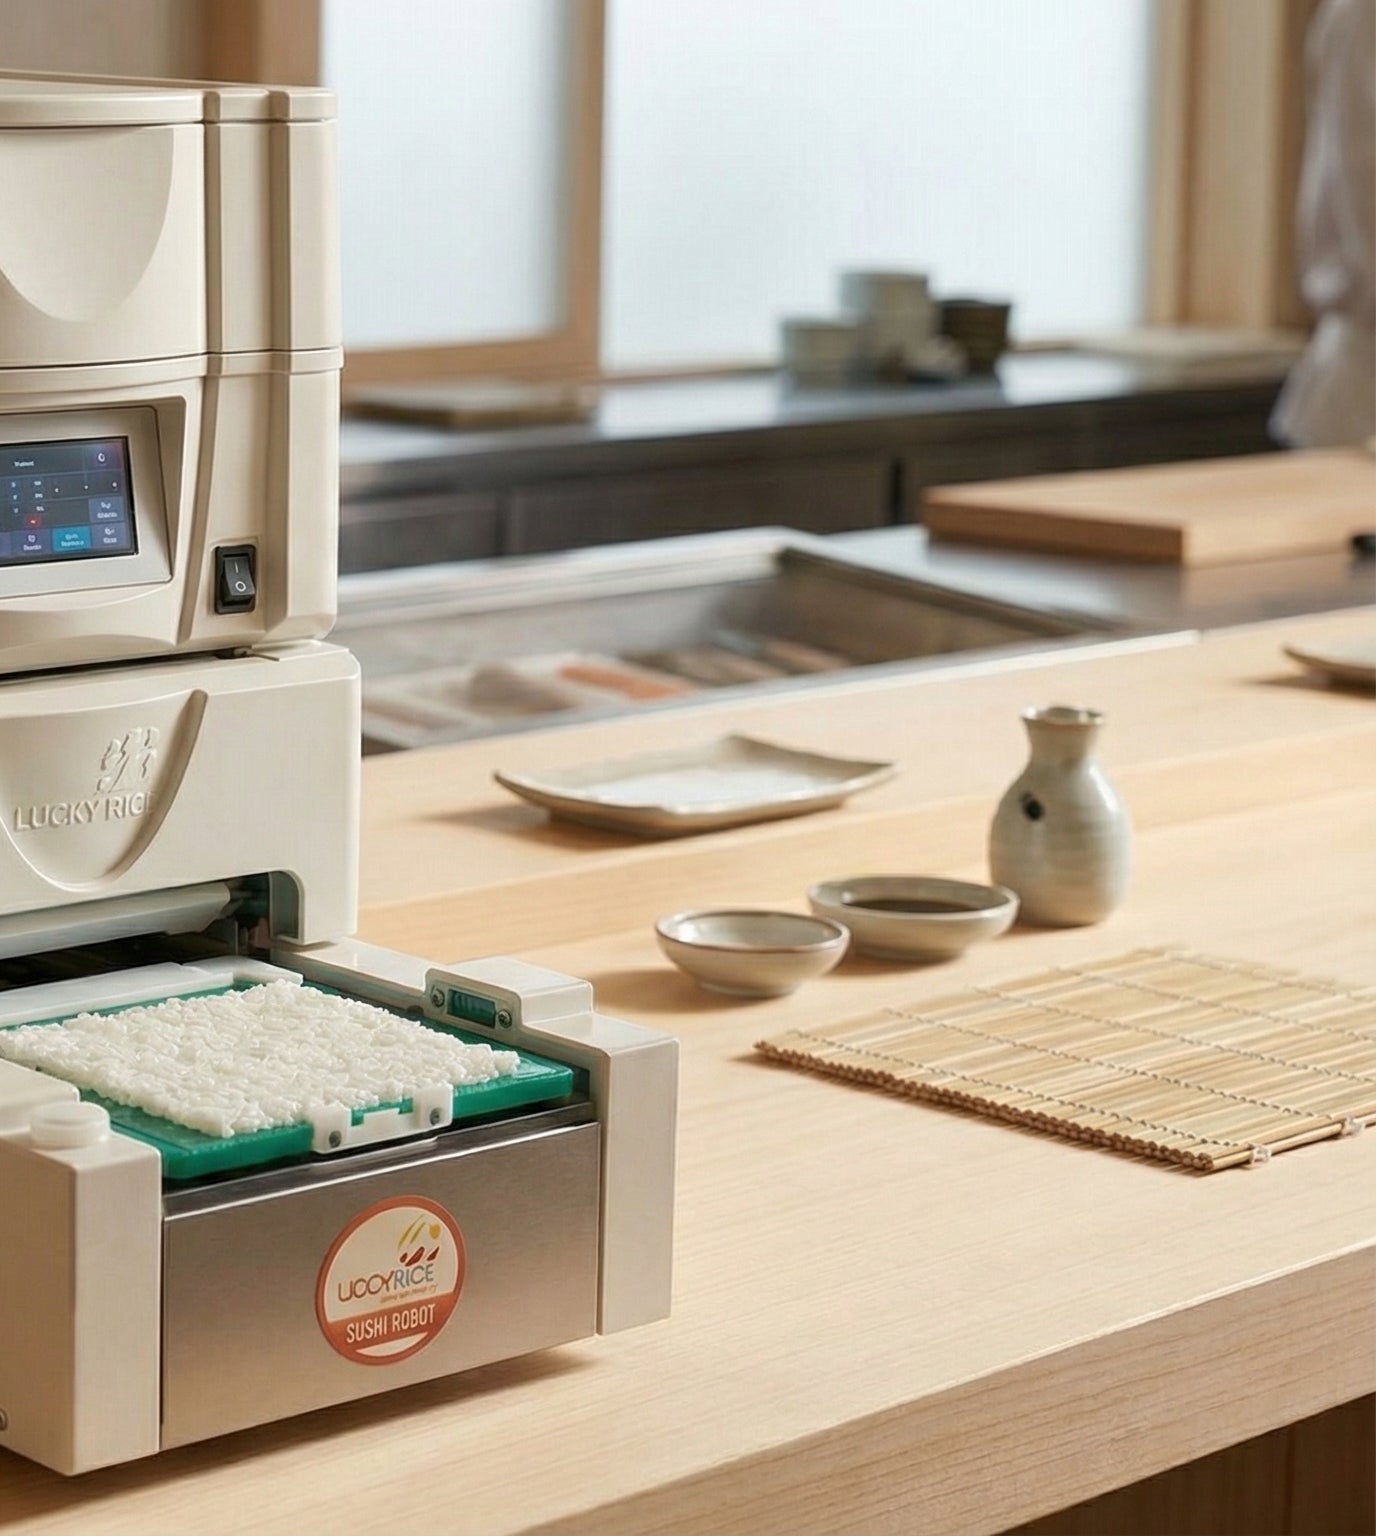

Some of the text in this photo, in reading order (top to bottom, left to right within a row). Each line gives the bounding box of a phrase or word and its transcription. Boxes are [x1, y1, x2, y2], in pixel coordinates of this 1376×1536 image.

[14, 799, 99, 831] LUCKY
[346, 1304, 436, 1344] SUSHI ROBOT
